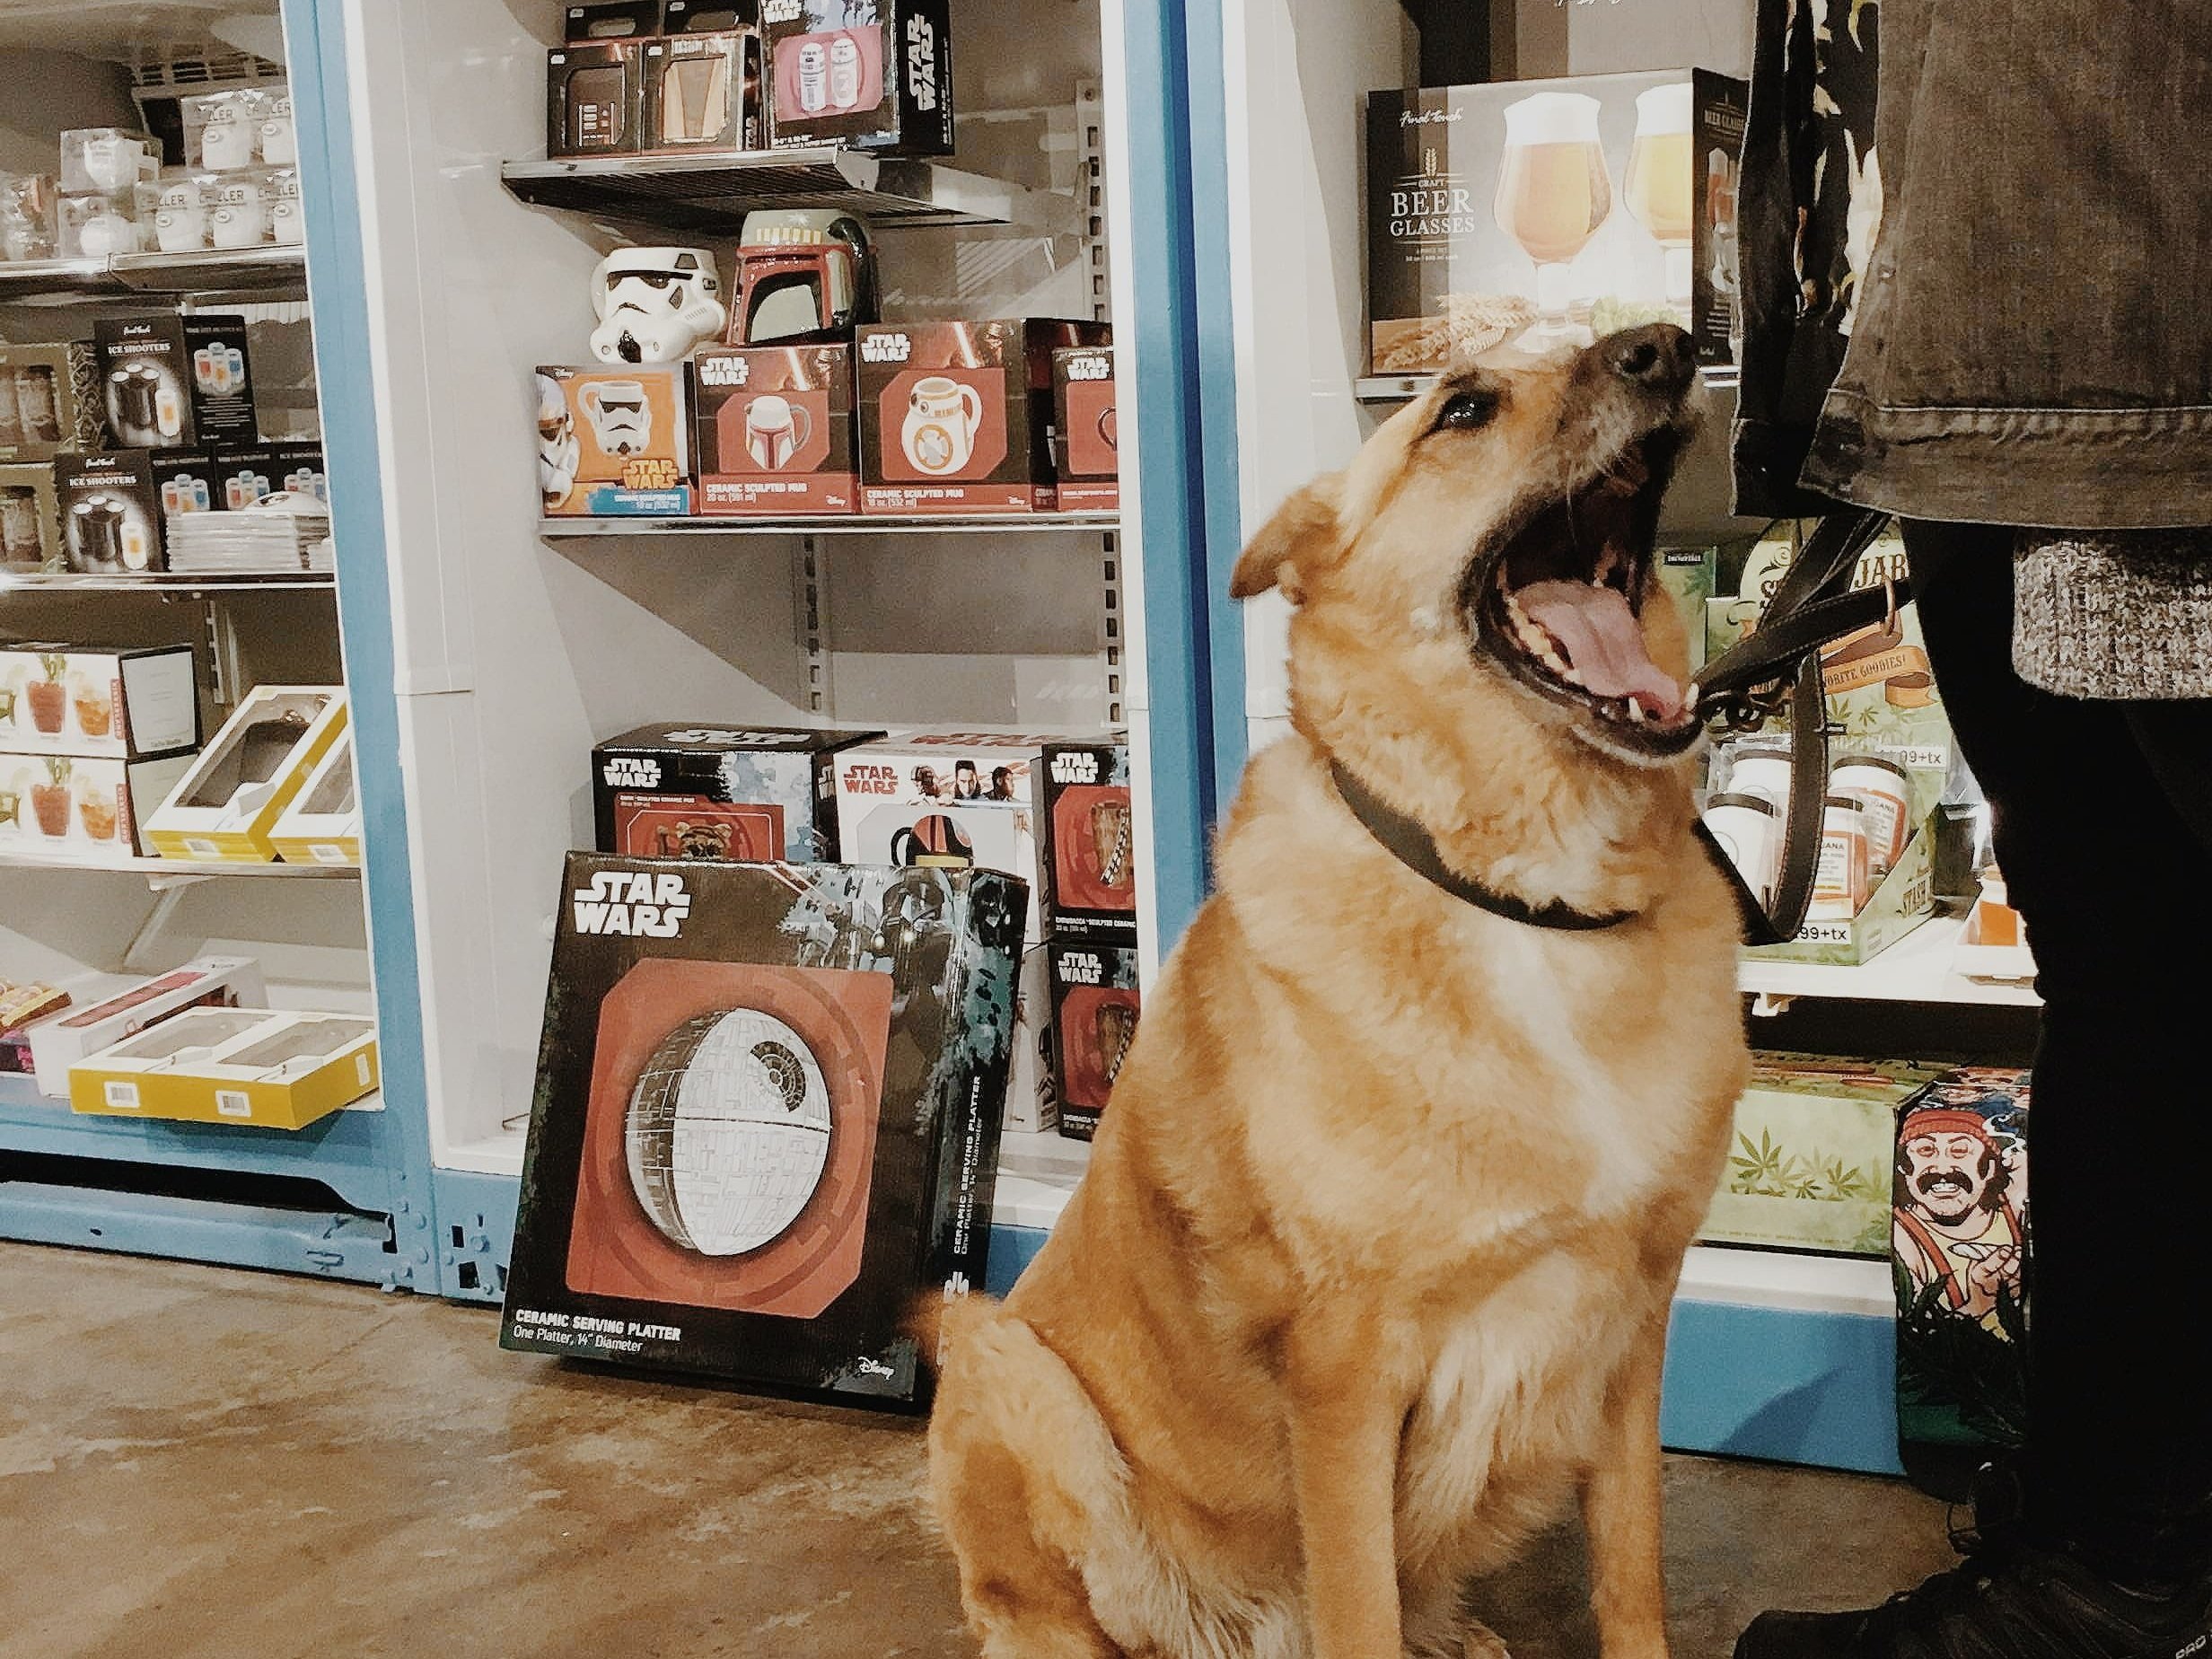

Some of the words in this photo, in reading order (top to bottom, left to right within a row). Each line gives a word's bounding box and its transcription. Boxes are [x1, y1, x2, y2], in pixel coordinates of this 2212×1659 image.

[763, 9, 801, 23] WARS
[907, 13, 923, 110] STAR
[919, 15, 936, 110] WARS
[1418, 180, 1444, 188] CRAFT
[1391, 188, 1475, 216] BEER
[1390, 216, 1475, 237] GLASSES
[861, 334, 911, 348] STAR
[862, 347, 910, 363] WARS
[1066, 357, 1110, 369] STAR
[700, 357, 749, 373] STAR
[700, 371, 749, 385] WARS
[1067, 368, 1110, 381] WARS
[623, 459, 678, 474] STAR
[624, 473, 677, 490] WARS
[1859, 653, 1906, 677] GOODIES!
[603, 758, 662, 774] STAR
[1050, 752, 1099, 768] STAR
[604, 773, 662, 788] WARS
[843, 765, 899, 780] STAR
[1051, 767, 1099, 784] WARS
[844, 779, 899, 794] WARS
[575, 871, 691, 907] STAR
[574, 902, 689, 938] WARS
[1058, 952, 1102, 969] STAR
[1058, 966, 1102, 984] WARS
[953, 1195, 967, 1254] CERAMIC
[961, 1136, 973, 1191] SERVING
[968, 1075, 980, 1132] PLATTER
[515, 1308, 570, 1328] CERAMIC
[572, 1315, 625, 1335] SERVING
[628, 1321, 682, 1342] PLATTER
[513, 1324, 534, 1339] One
[536, 1327, 575, 1347] Platter,
[594, 1334, 644, 1353] Diameter
[857, 1356, 895, 1381] Disney
